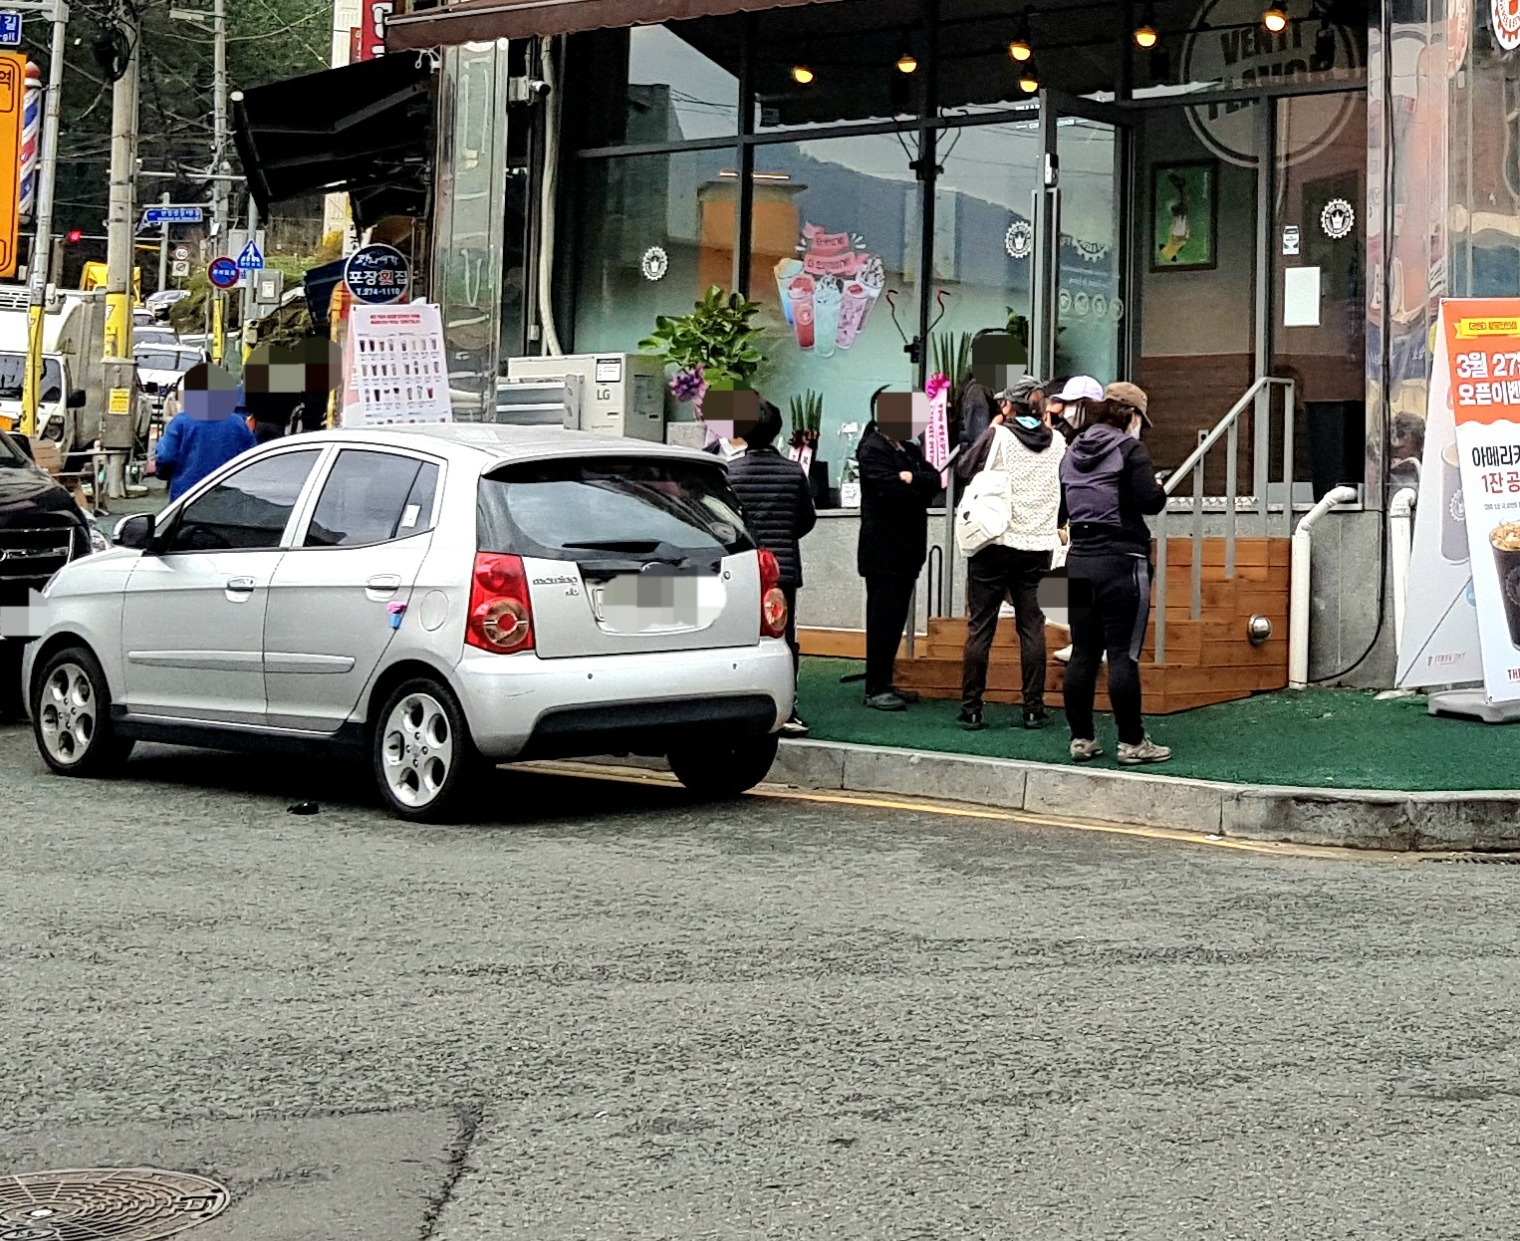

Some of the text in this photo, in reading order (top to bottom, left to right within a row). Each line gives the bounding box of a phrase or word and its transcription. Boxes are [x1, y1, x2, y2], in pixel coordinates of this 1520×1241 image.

[1456, 352, 1488, 378] 3월
[597, 389, 611, 401] LG
[1482, 472, 1503, 493] 1잔
